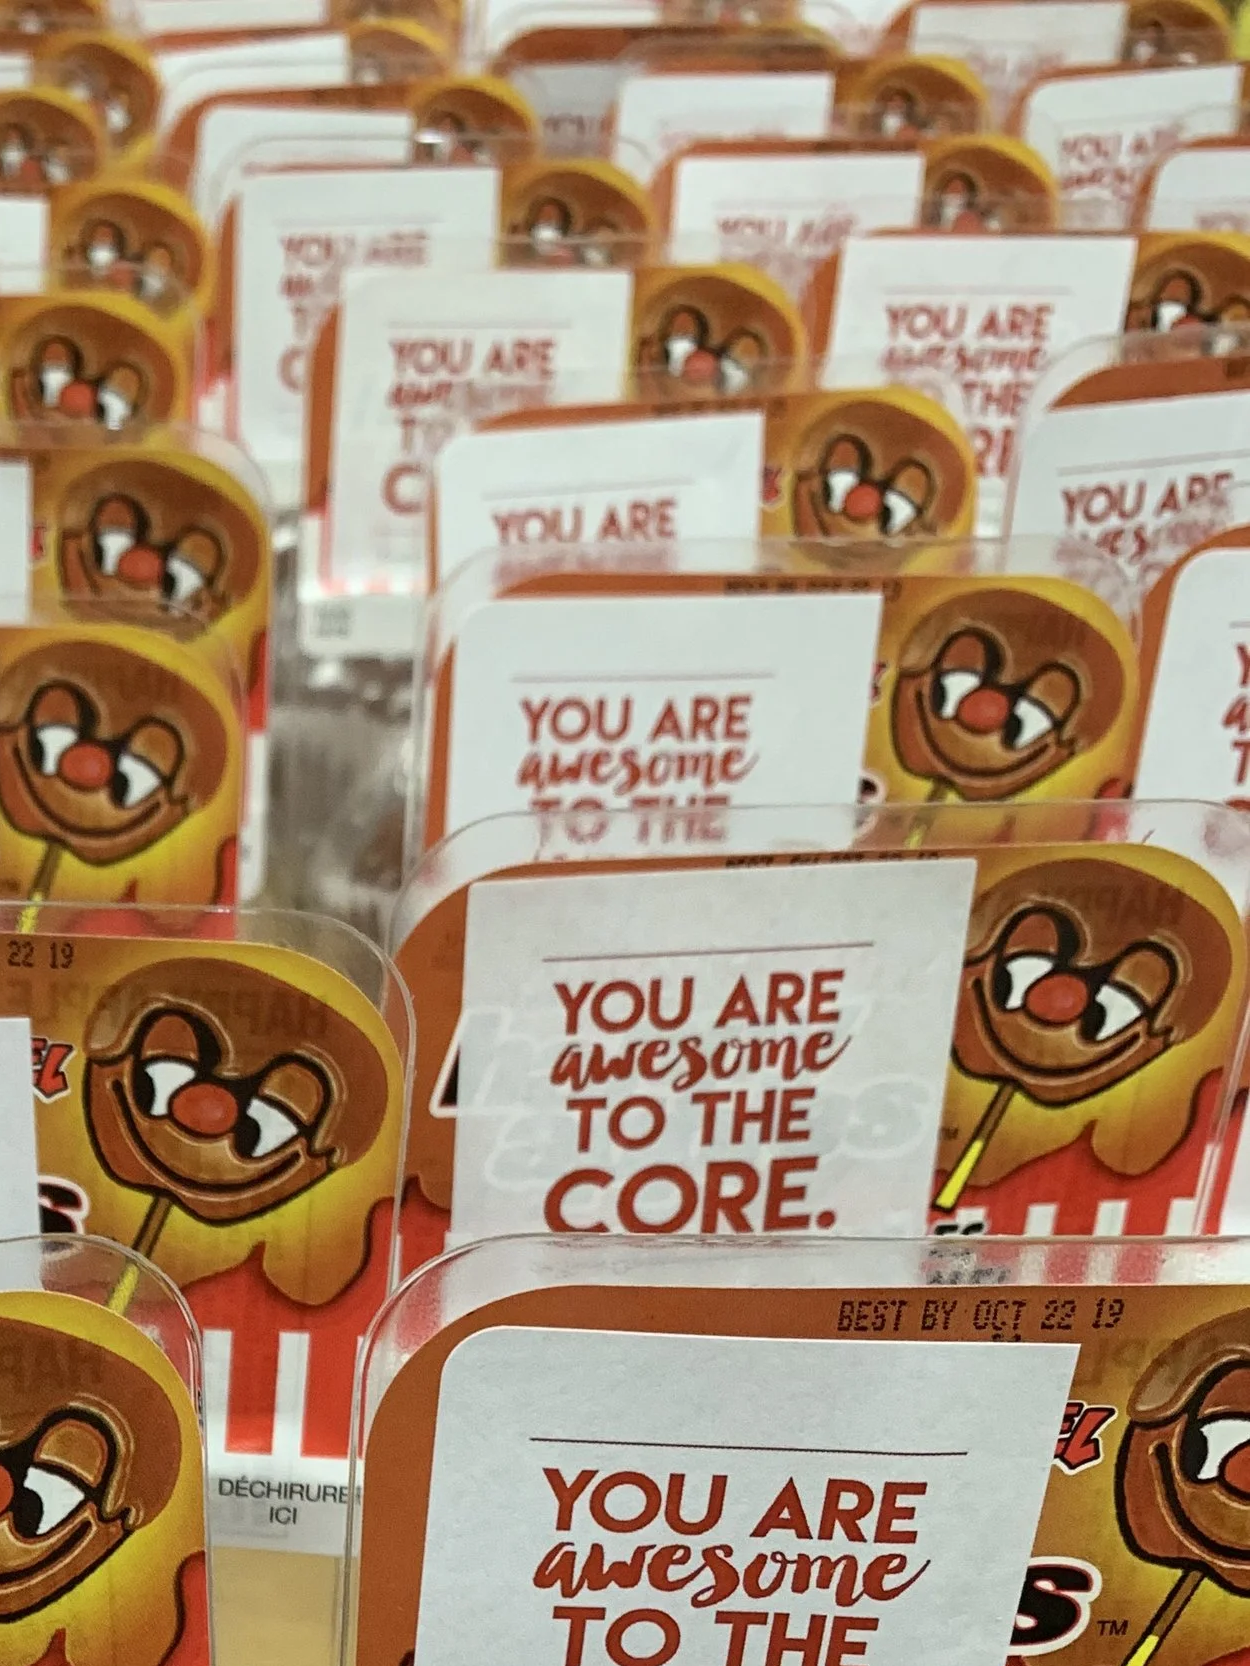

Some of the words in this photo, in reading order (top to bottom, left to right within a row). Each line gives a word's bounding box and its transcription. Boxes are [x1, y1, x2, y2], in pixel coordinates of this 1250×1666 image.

[885, 305, 965, 341] YOU
[973, 304, 1055, 339] ARE
[389, 339, 473, 375] YOU
[484, 338, 559, 374] ARE
[492, 506, 584, 546] YOU
[595, 498, 678, 541] ARE
[1060, 480, 1149, 527] YOU
[518, 696, 632, 745] YOU
[647, 694, 753, 744] ARE
[516, 745, 760, 797] awesome
[7, 940, 35, 968] 22
[49, 942, 75, 969] 19
[553, 976, 695, 1036] YOU
[714, 969, 846, 1030] ARE
[550, 1034, 853, 1093] awesome
[566, 1095, 666, 1154] TO
[690, 1087, 816, 1147] THE
[543, 1156, 838, 1235] CORE.
[837, 1299, 908, 1332] BEST
[921, 1299, 957, 1332] BY
[972, 1299, 1027, 1332] OCT
[1040, 1299, 1079, 1331] 22
[1092, 1297, 1126, 1330] 19
[269, 1506, 298, 1525] ICI
[542, 1467, 729, 1537] YOU
[749, 1476, 929, 1545] ARE
[532, 1541, 932, 1609] awesome
[1098, 1619, 1129, 1638] TM
